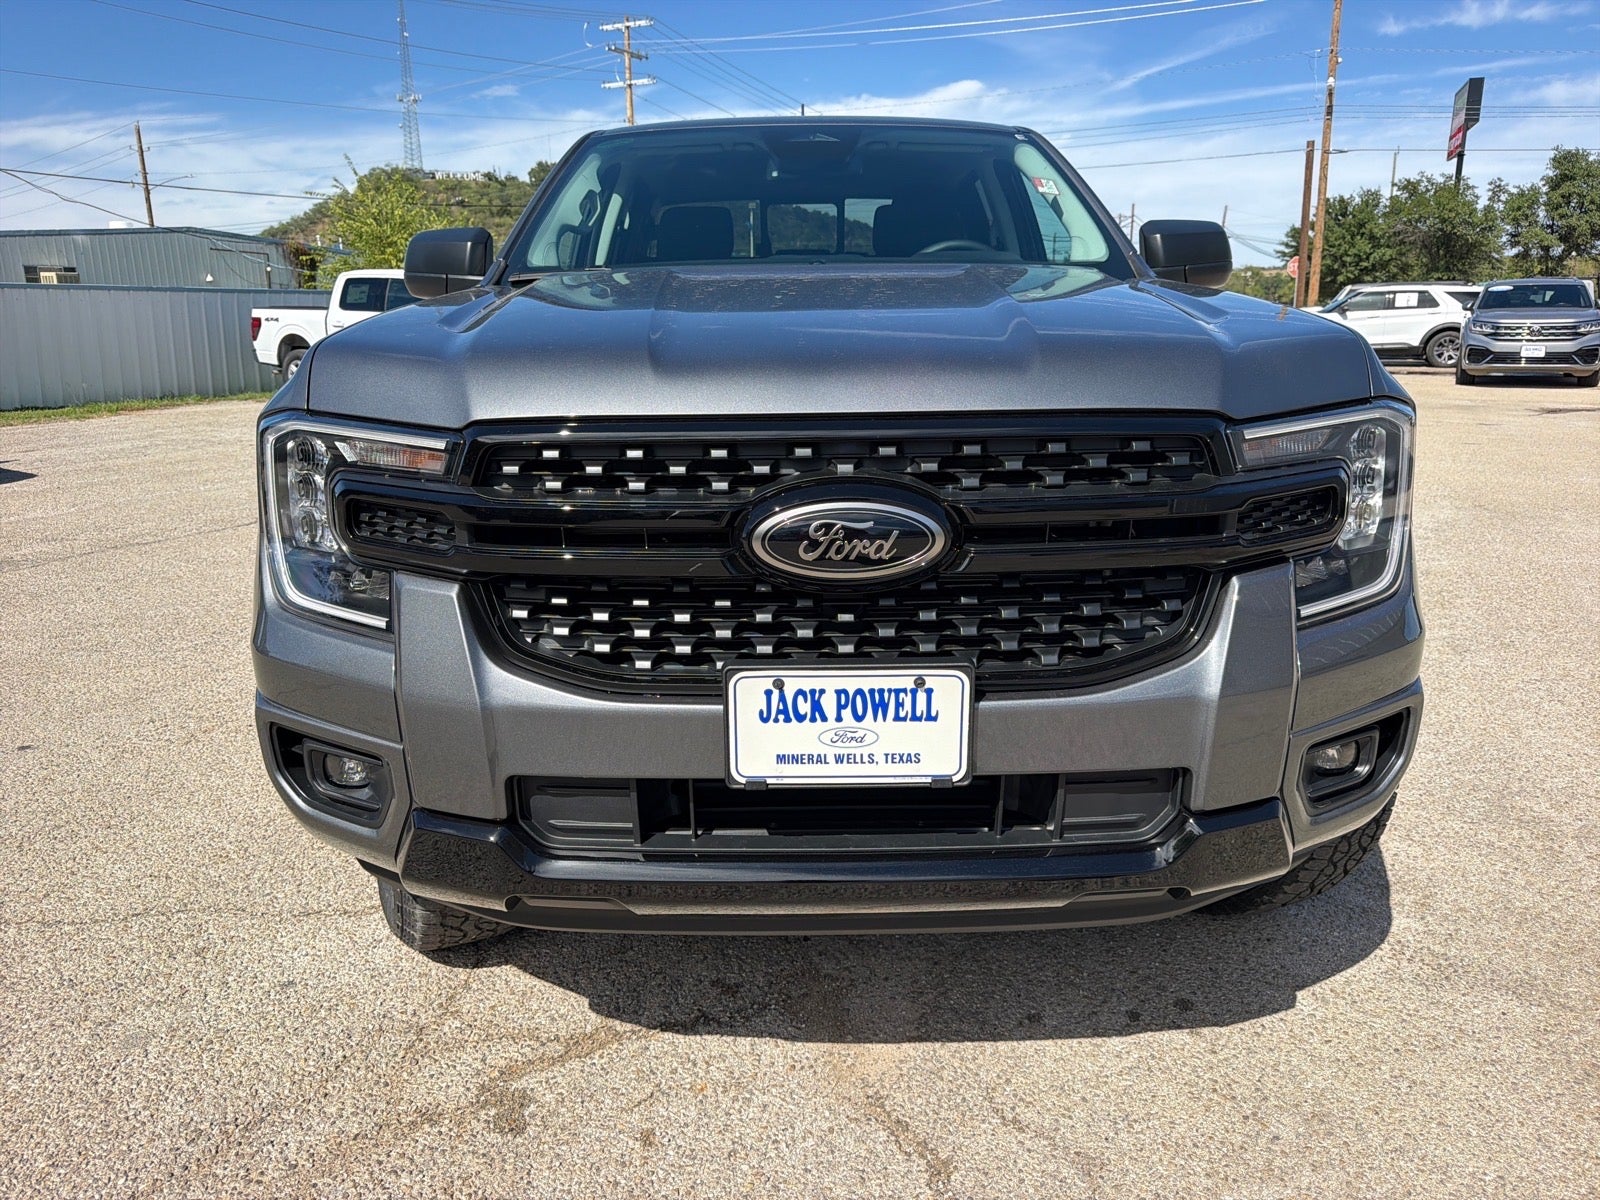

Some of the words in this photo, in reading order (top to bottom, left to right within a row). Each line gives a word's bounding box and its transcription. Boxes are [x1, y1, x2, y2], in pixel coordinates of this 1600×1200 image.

[798, 519, 900, 562] Ford
[758, 688, 829, 724] JACK
[834, 687, 939, 723] POWELL
[830, 730, 867, 744] Ford
[775, 753, 830, 765] MINERAL
[833, 753, 879, 766] WELLS,
[883, 752, 921, 764] TEXAS
